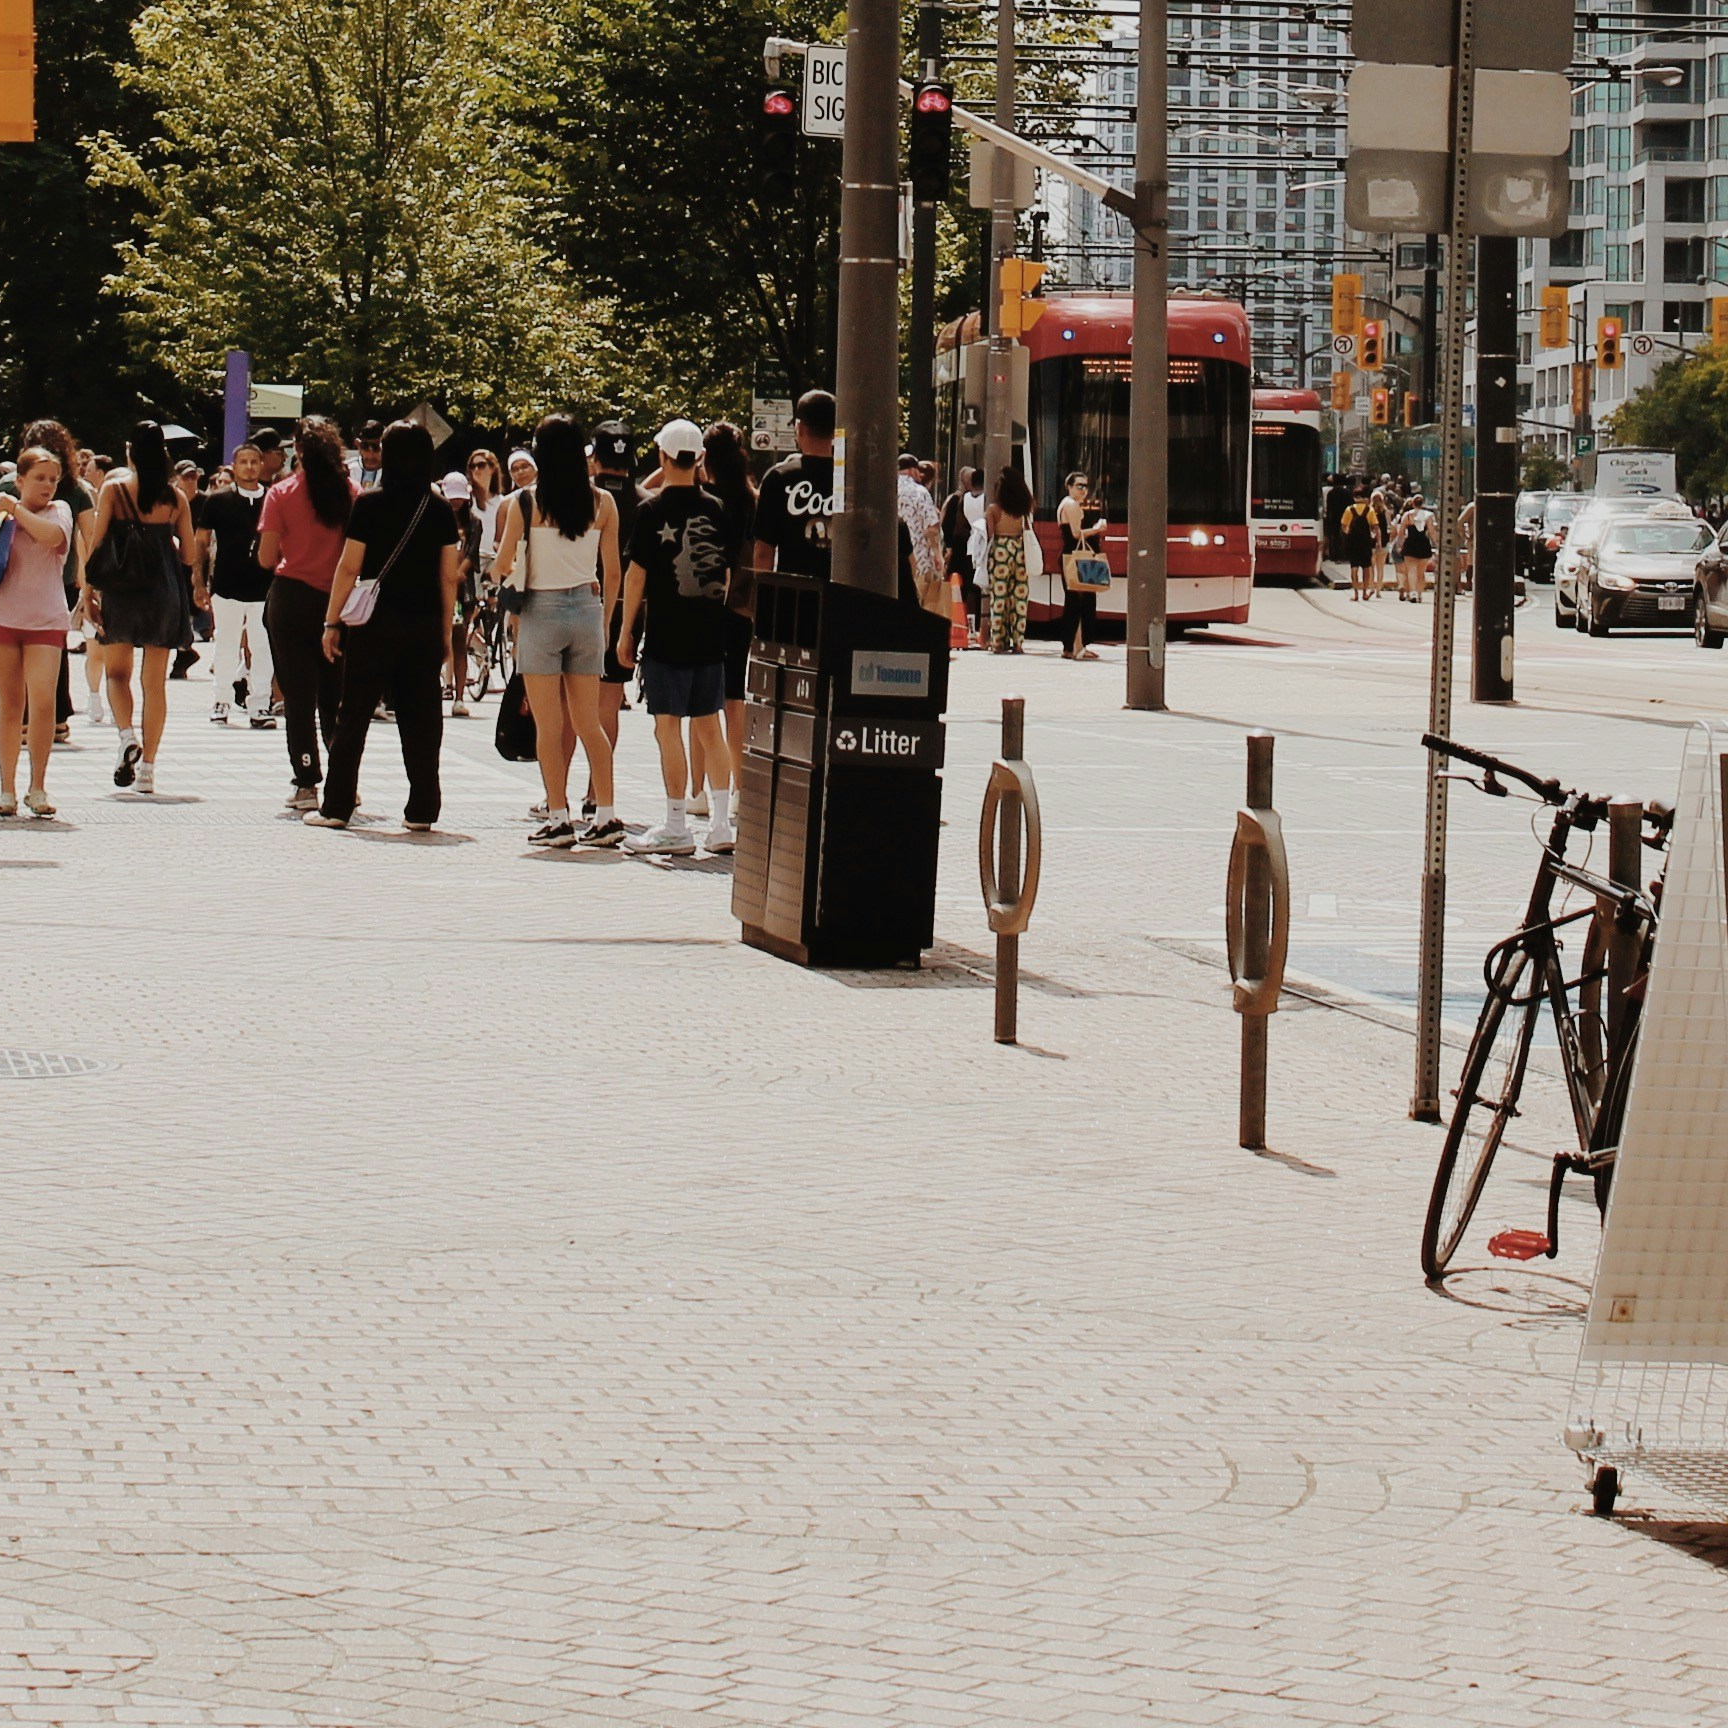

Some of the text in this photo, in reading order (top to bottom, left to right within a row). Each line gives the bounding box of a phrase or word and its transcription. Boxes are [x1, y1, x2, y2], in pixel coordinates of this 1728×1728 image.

[1578, 438, 1589, 450] P
[861, 727, 921, 755] Litter
[301, 753, 311, 767] 9
